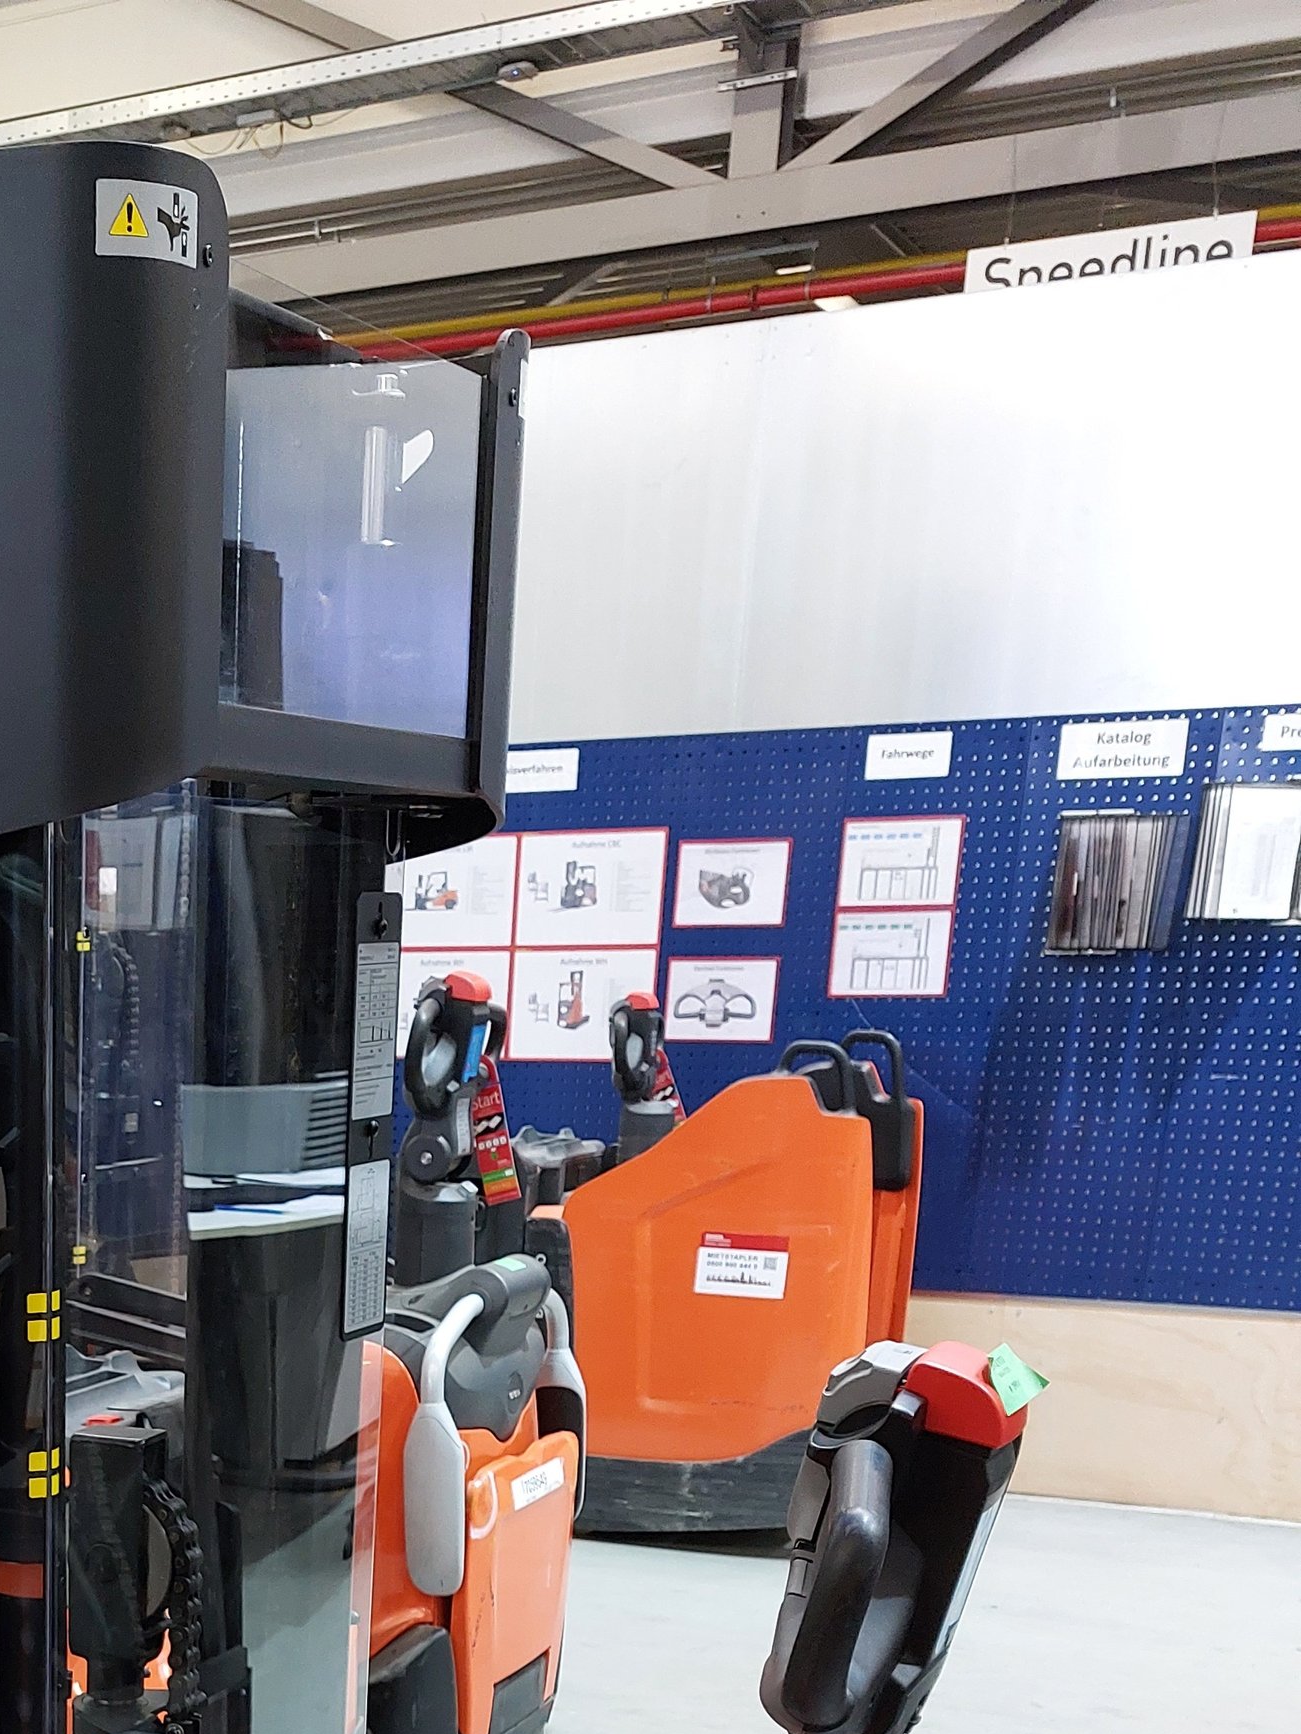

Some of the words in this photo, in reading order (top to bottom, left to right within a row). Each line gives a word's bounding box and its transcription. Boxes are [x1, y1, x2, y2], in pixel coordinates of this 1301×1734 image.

[1096, 731, 1152, 745] Katalog
[881, 749, 935, 760] Fahrwege
[1072, 753, 1171, 768] Aufarbeitung
